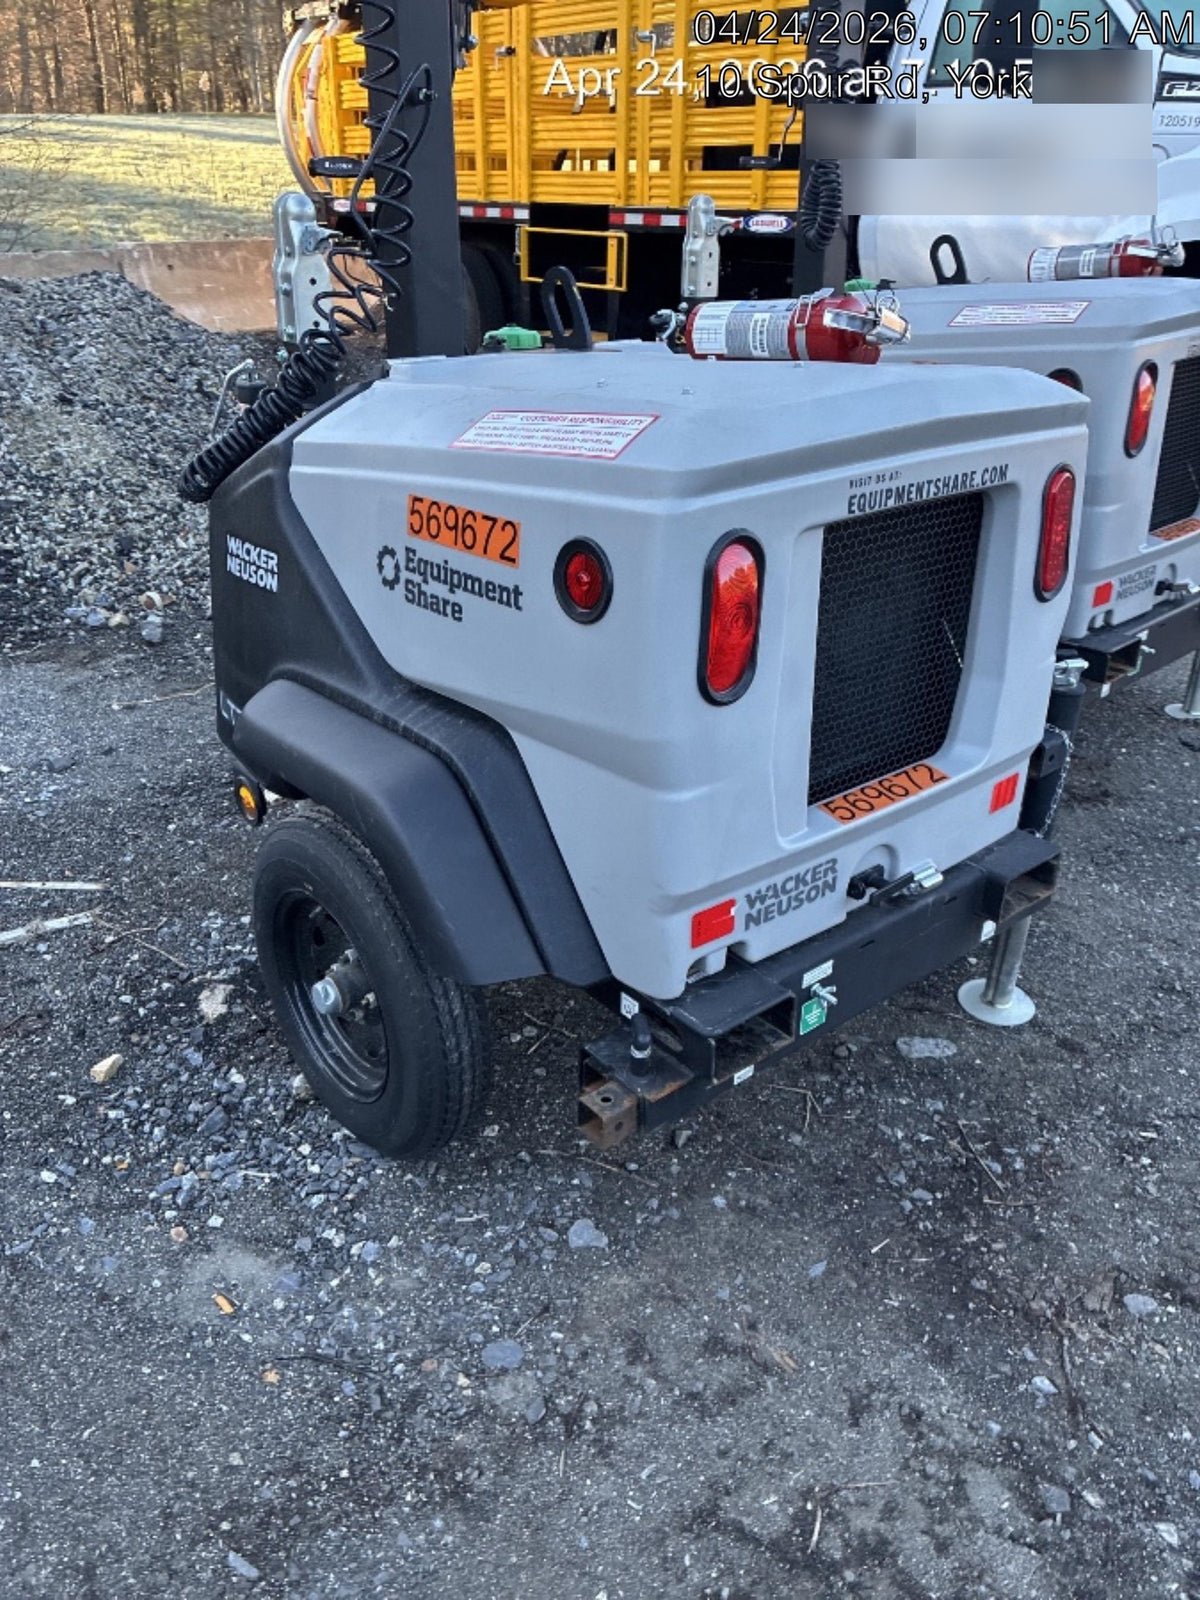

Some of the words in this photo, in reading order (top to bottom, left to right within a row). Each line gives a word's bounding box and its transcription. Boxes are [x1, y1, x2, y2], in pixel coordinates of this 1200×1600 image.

[847, 463, 1009, 515] EQUIPMENTSHARE.COM
[226, 533, 279, 574] WACKER
[409, 495, 518, 565] 569672
[226, 553, 279, 593] NEUSON
[404, 545, 524, 612] Equipment
[404, 577, 464, 623] Share
[824, 763, 948, 822] 569672
[744, 857, 838, 911] WACKER
[744, 874, 838, 932] NEUSON
